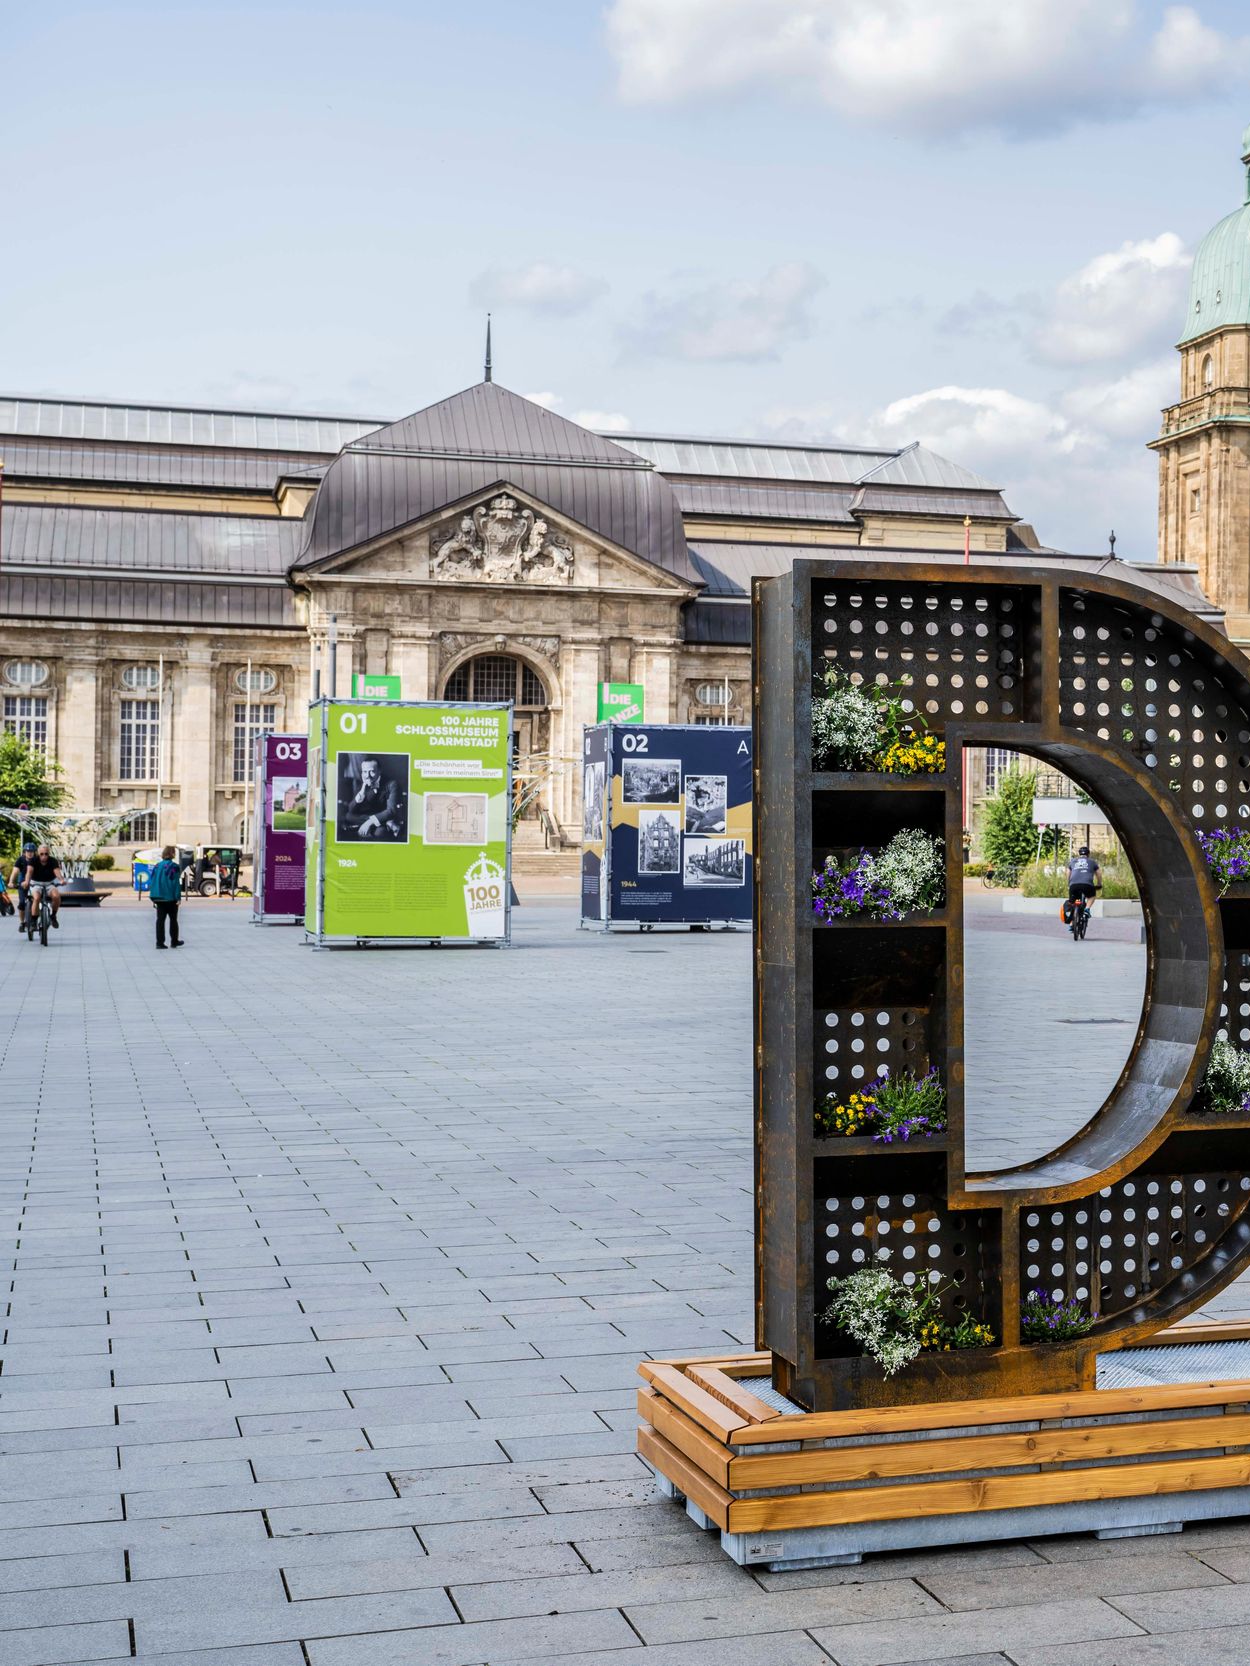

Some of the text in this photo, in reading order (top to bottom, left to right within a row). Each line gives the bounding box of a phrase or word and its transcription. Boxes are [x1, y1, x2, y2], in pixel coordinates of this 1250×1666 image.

[610, 694, 631, 704] DIE
[340, 712, 367, 734] 01
[441, 715, 499, 727] 100 JAHRE
[395, 724, 499, 737] SCHLOSSMUSEUM
[429, 736, 499, 748] DARMSTADT
[622, 734, 649, 752] 02
[275, 742, 302, 760] 03
[337, 859, 357, 868] 1924
[467, 885, 500, 901] 100
[470, 899, 502, 910] JAHRE
